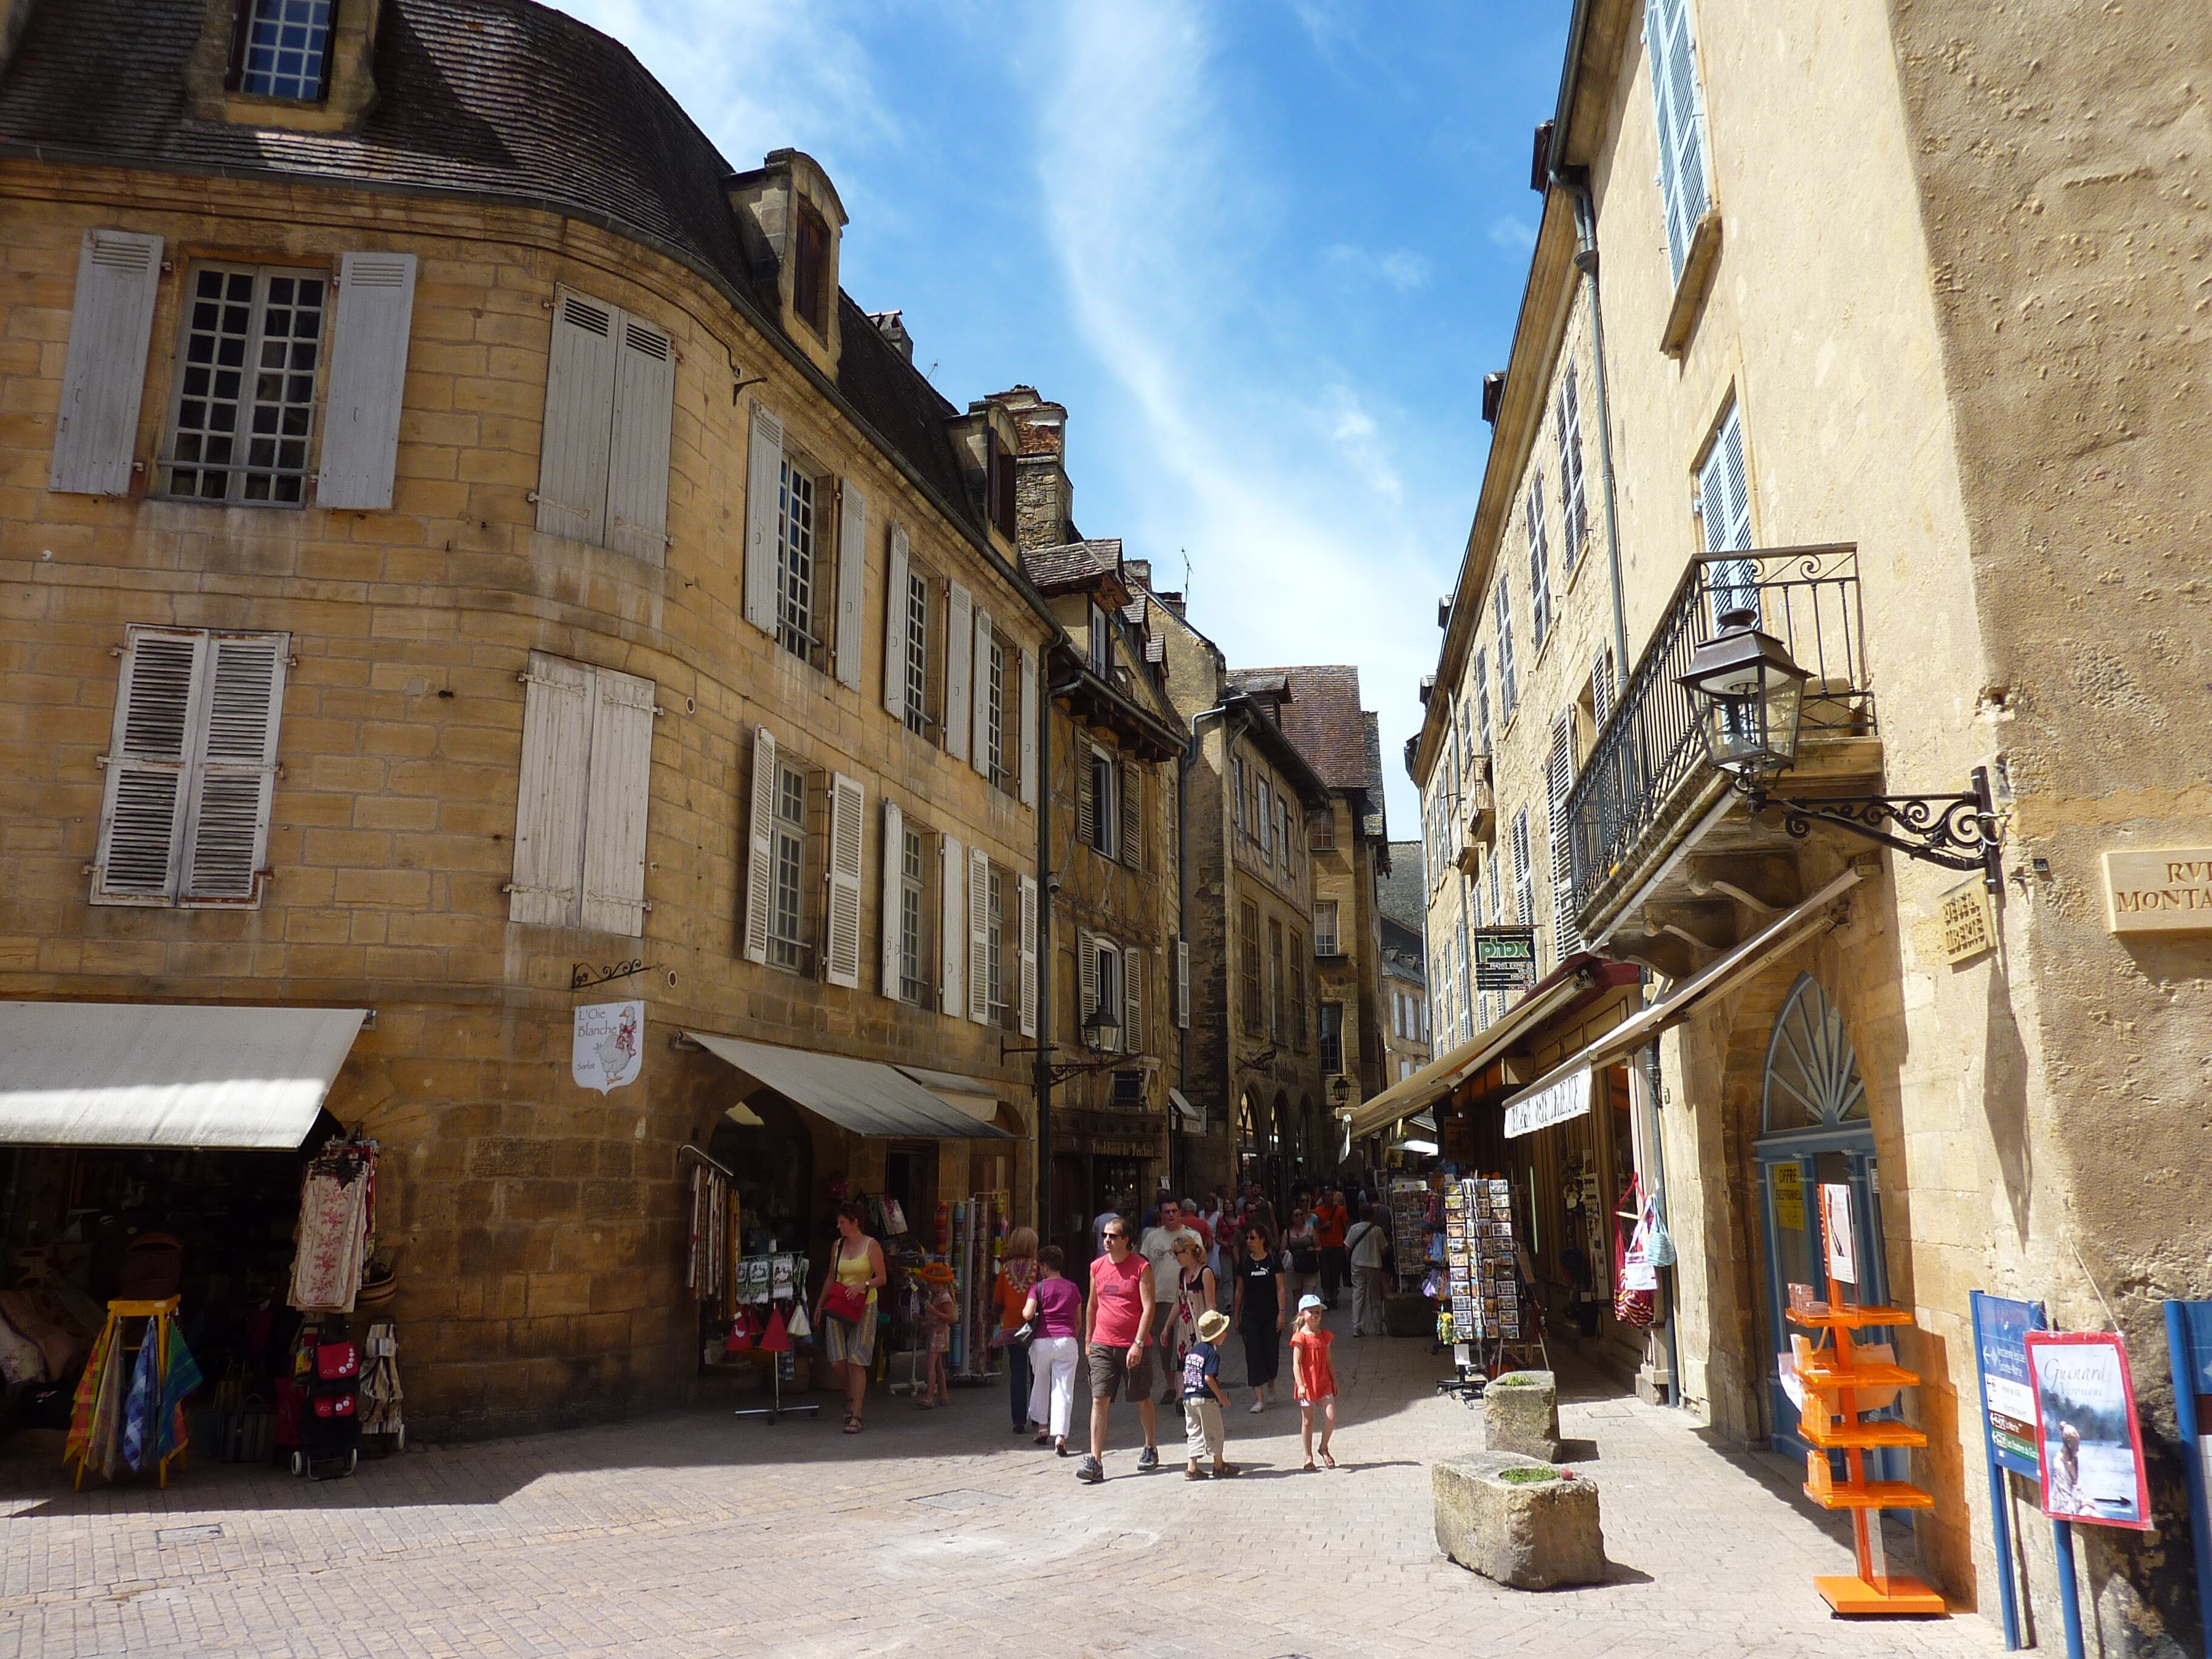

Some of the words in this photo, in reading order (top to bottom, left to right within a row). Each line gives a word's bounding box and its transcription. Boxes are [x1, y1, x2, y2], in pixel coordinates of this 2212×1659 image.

[1478, 937, 1531, 962] phox
[578, 1008, 606, 1021] L'Oie
[578, 1020, 617, 1037] Blanche
[577, 1061, 595, 1070] Sarlat
[1779, 1168, 1797, 1184] OFFRE
[2044, 1356, 2108, 1390] Guinard
